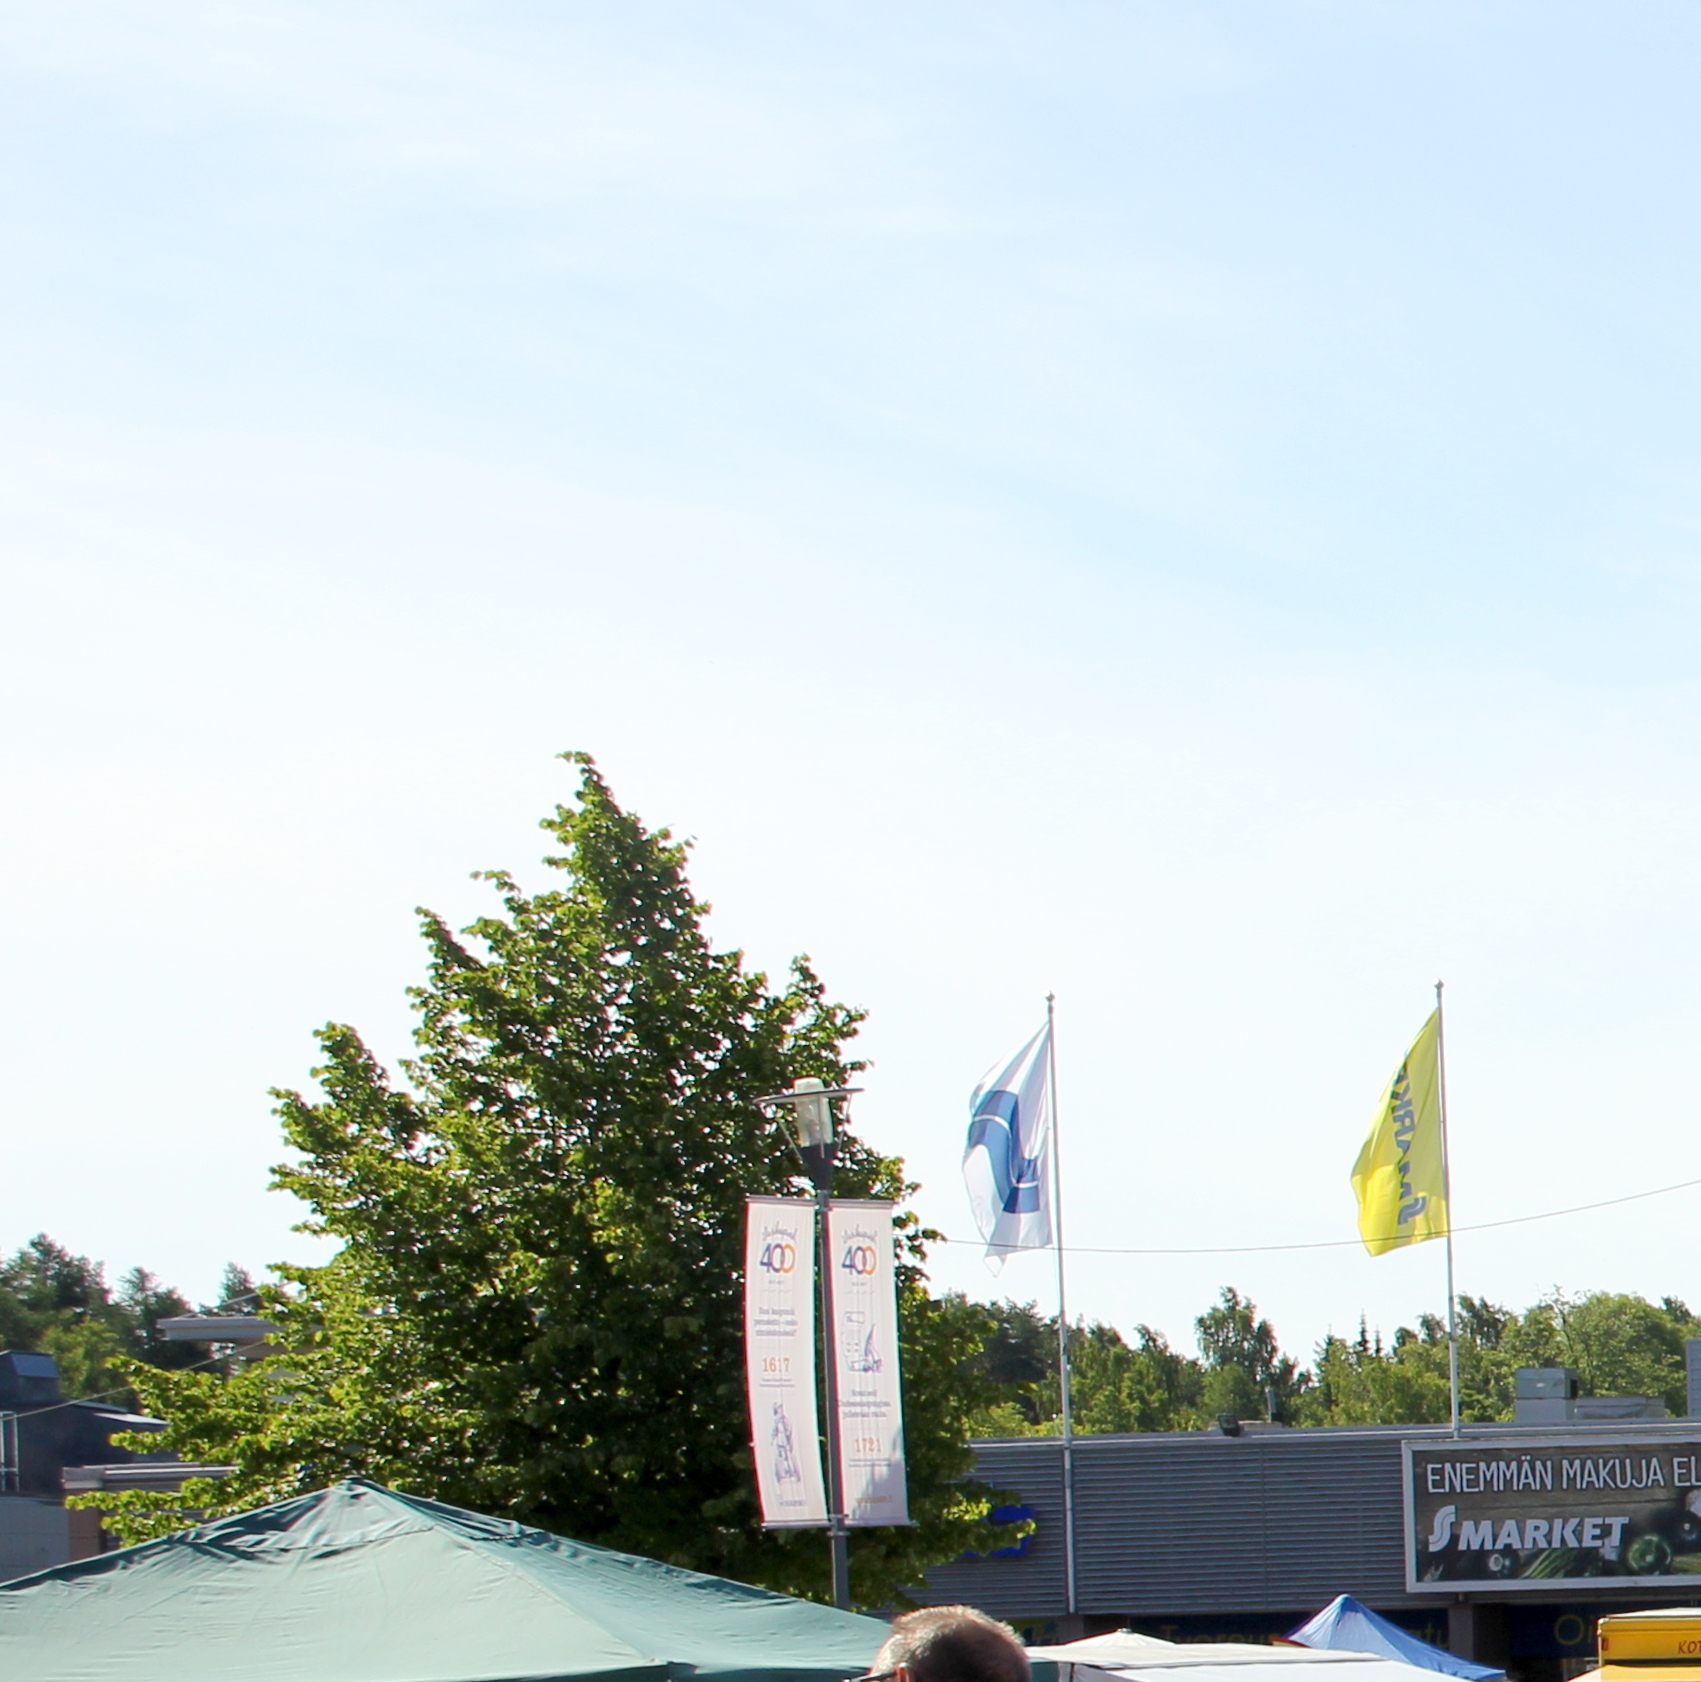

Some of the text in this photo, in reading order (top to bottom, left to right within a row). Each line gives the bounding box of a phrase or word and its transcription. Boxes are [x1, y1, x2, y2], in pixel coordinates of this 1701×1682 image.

[759, 1243, 796, 1274] 400
[841, 1245, 877, 1276] 400
[762, 1358, 791, 1373] 1617
[855, 1437, 883, 1453] 1721
[1426, 1456, 1553, 1494] ENEMMÄN
[1562, 1457, 1665, 1490] MAKUJA
[1458, 1516, 1630, 1551] MARKET
